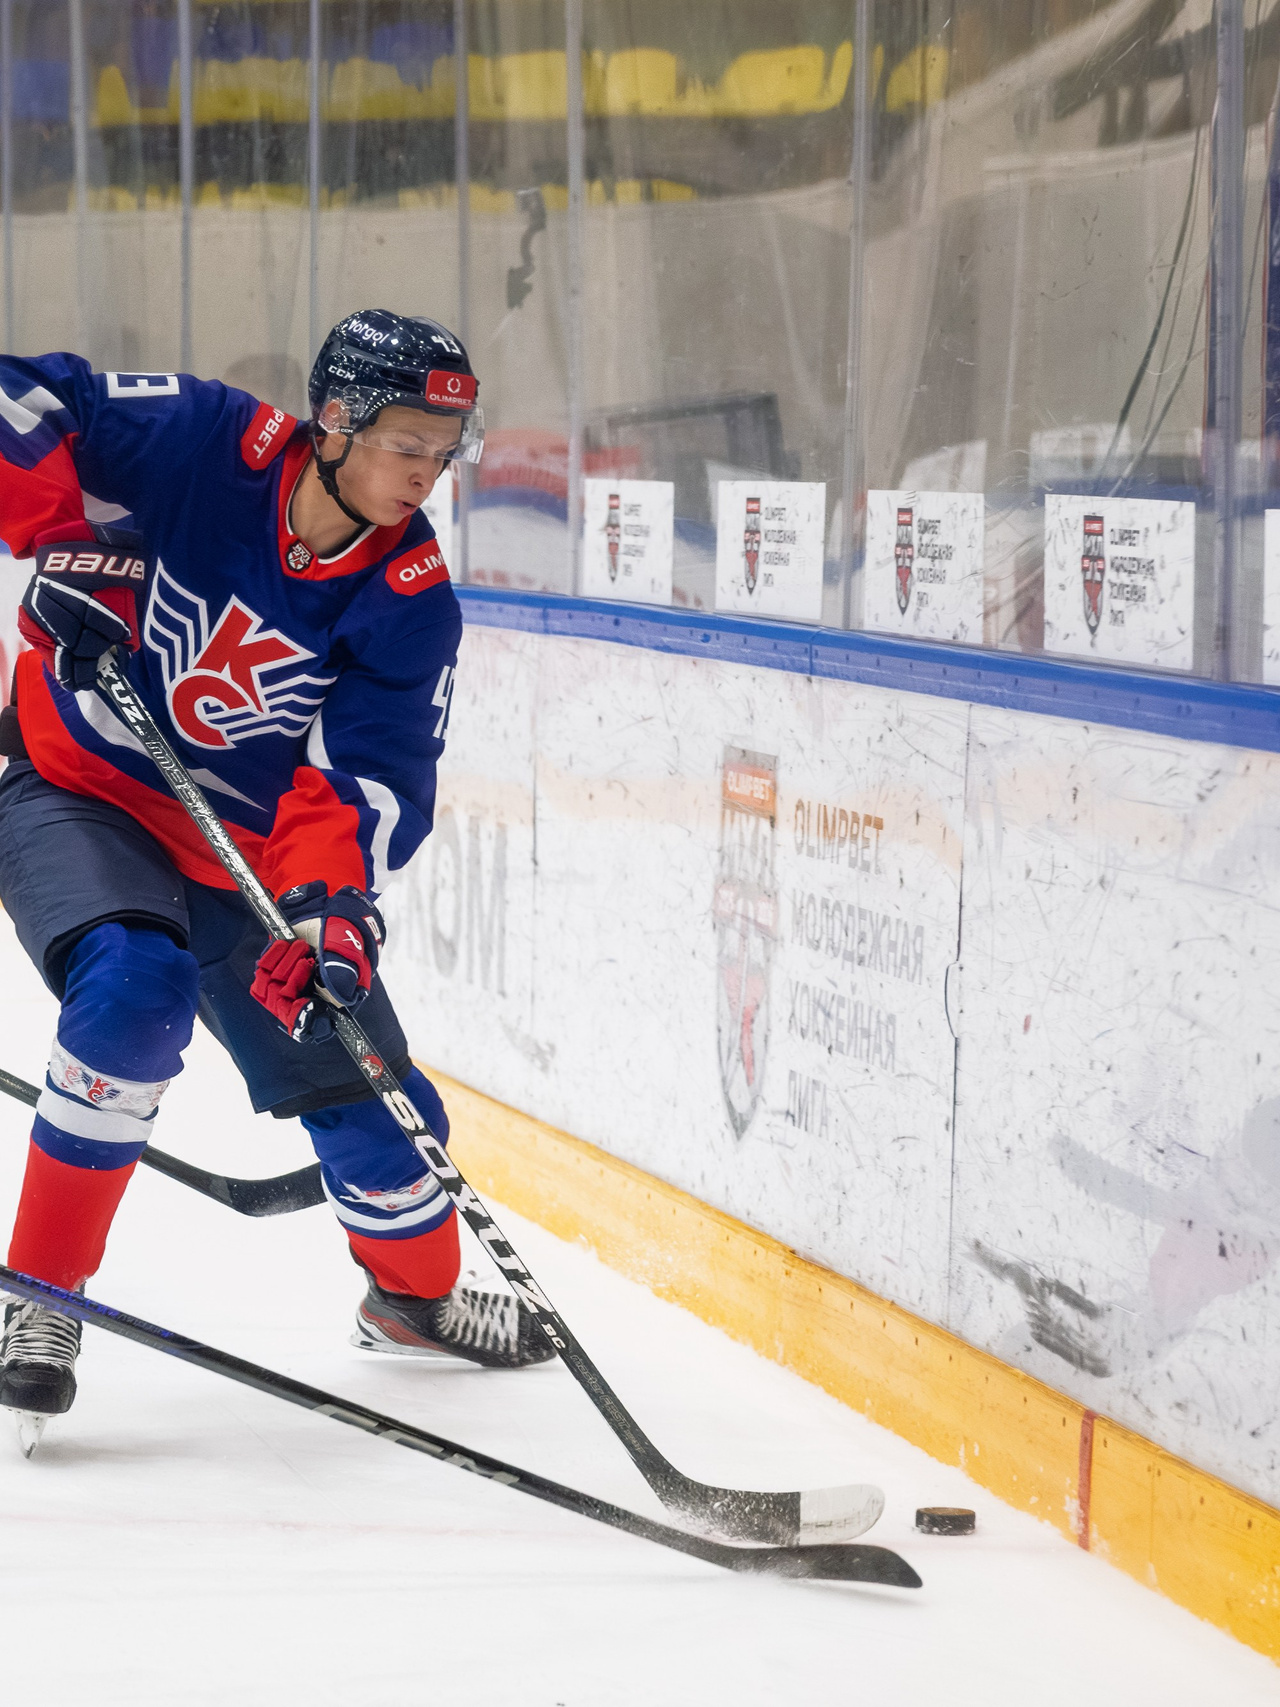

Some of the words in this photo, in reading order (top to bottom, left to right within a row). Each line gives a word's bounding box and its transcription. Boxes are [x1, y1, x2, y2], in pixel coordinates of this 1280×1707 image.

[328, 365, 356, 381] CCM
[429, 393, 472, 406] OLIMPBET
[252, 406, 285, 460] PBET
[788, 1069, 831, 1140] ЛИГА
[382, 1089, 555, 1315] SOYUZ
[540, 1321, 567, 1350] BC
